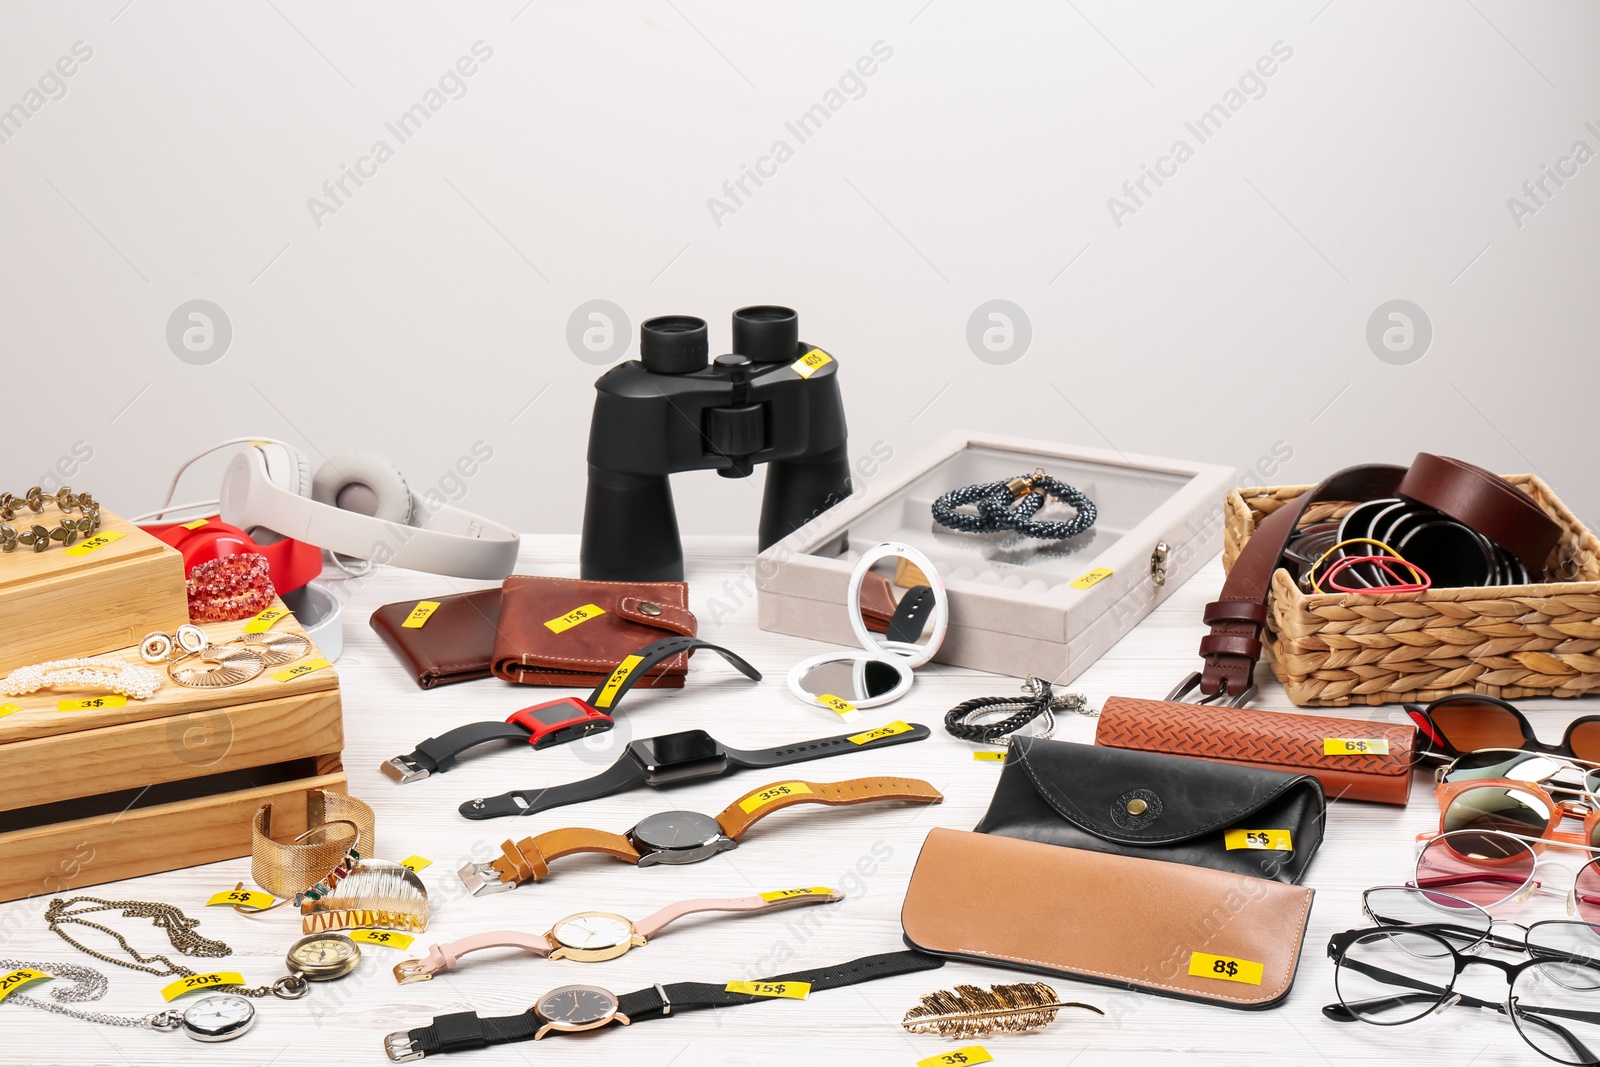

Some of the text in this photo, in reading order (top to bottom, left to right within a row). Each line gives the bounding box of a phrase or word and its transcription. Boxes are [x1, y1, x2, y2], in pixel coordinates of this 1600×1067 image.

[804, 354, 822, 368] 40$
[82, 537, 109, 549] 15$
[412, 606, 430, 620] 15$
[562, 610, 588, 625] 15$
[608, 667, 629, 689] 15$
[81, 698, 104, 708] 3$
[828, 699, 848, 710] 5$
[866, 727, 894, 739] 25$
[1345, 740, 1367, 752] 6$
[759, 786, 791, 801] 35$
[1246, 832, 1270, 846] 5$
[227, 891, 251, 902] 5$
[780, 888, 813, 896] 15$
[367, 931, 391, 942] 5$
[1213, 960, 1239, 977] 8$
[0, 971, 32, 990] 20$
[184, 974, 222, 987] 20$
[752, 983, 786, 995] 15$
[941, 1052, 968, 1065] 3$
